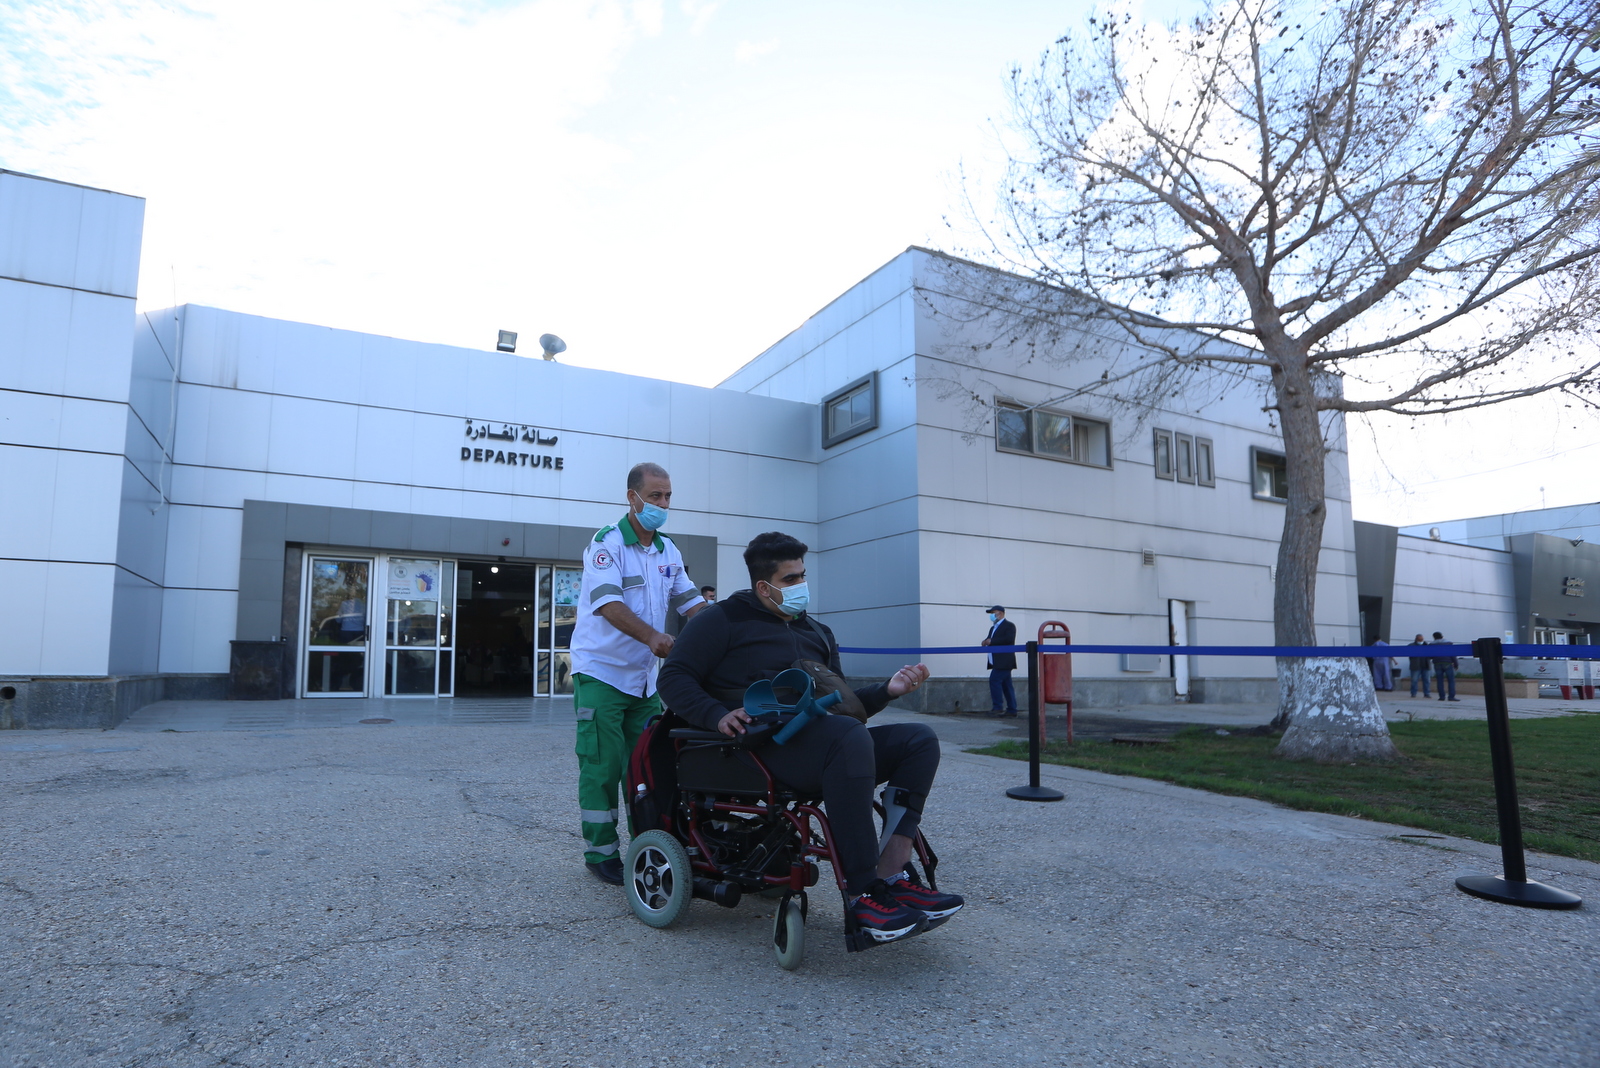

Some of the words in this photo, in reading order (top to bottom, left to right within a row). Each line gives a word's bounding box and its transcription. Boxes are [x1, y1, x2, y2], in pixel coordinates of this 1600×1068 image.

[465, 418, 518, 441] المغادرة
[521, 425, 558, 446] صالة
[461, 447, 564, 470] DEPARTURE
